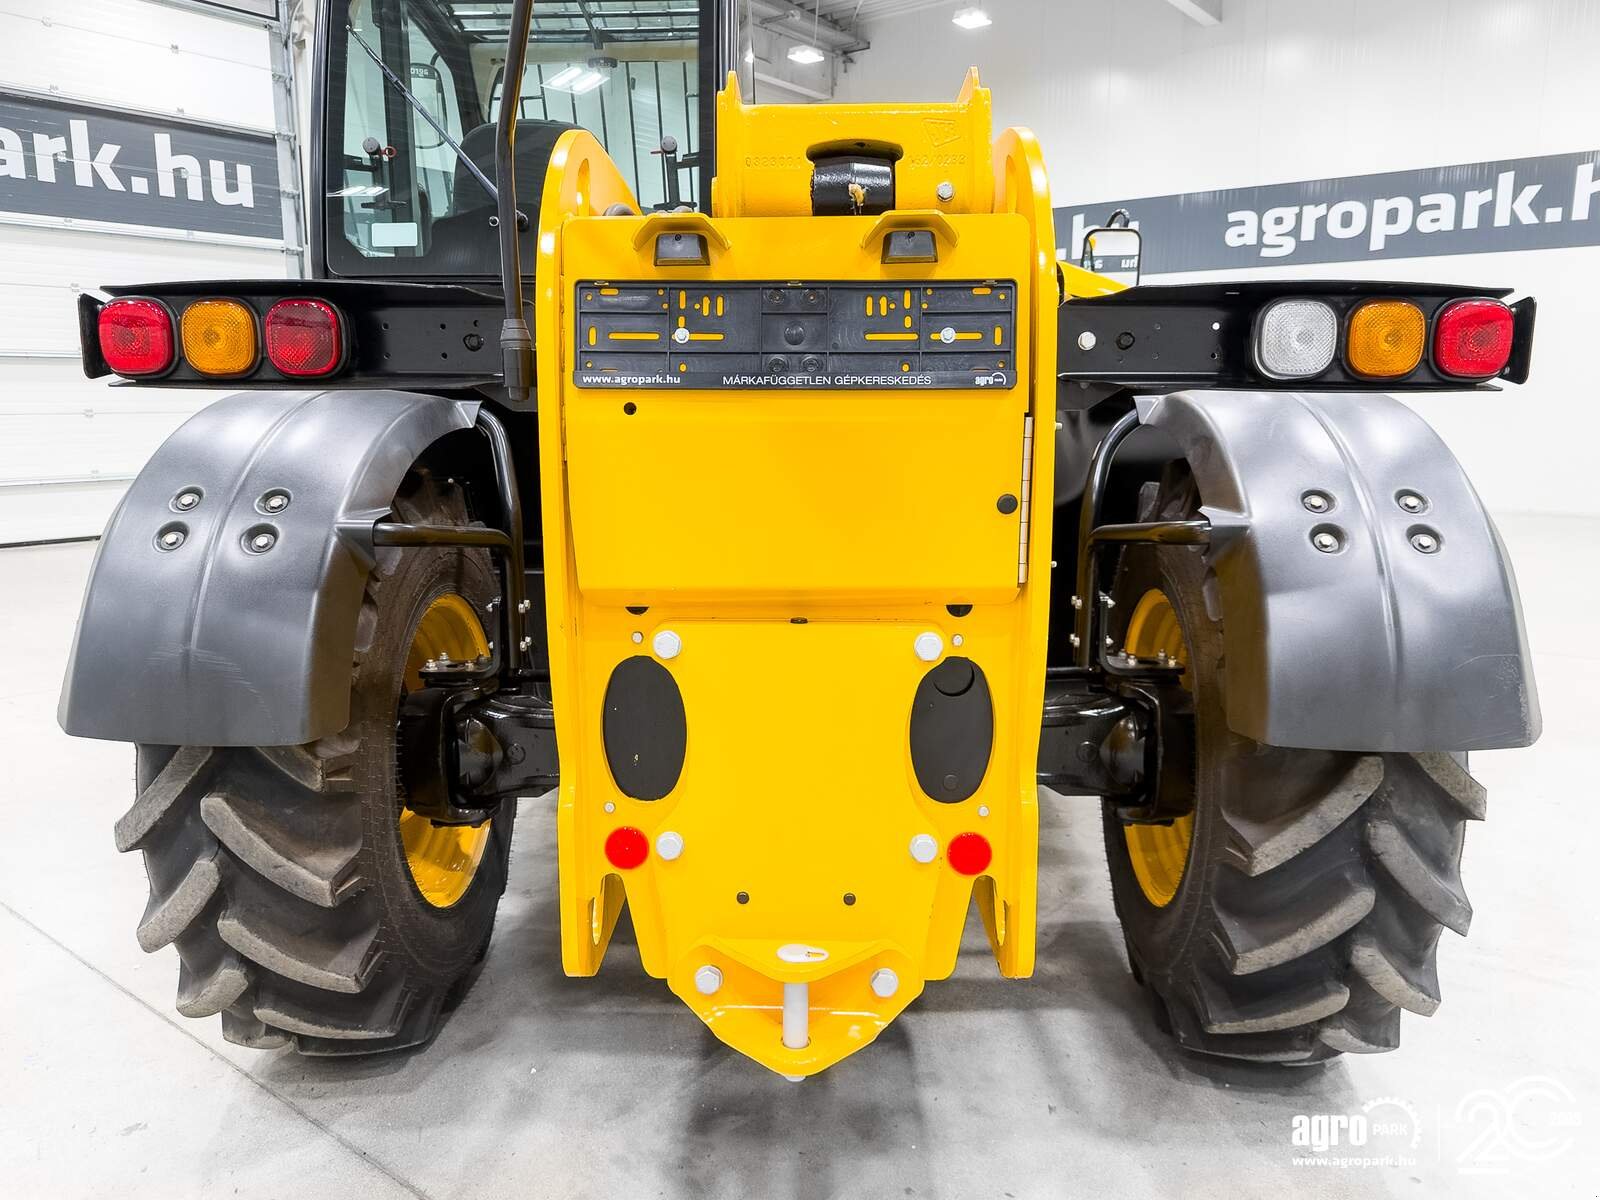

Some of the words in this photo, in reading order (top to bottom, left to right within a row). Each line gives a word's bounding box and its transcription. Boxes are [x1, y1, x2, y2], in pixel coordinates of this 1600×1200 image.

[582, 374, 681, 385] www.agropark.hu
[722, 373, 832, 385] MÁRKAFÜGGETLEN
[834, 374, 932, 385] GÉPKERESKEDÉS
